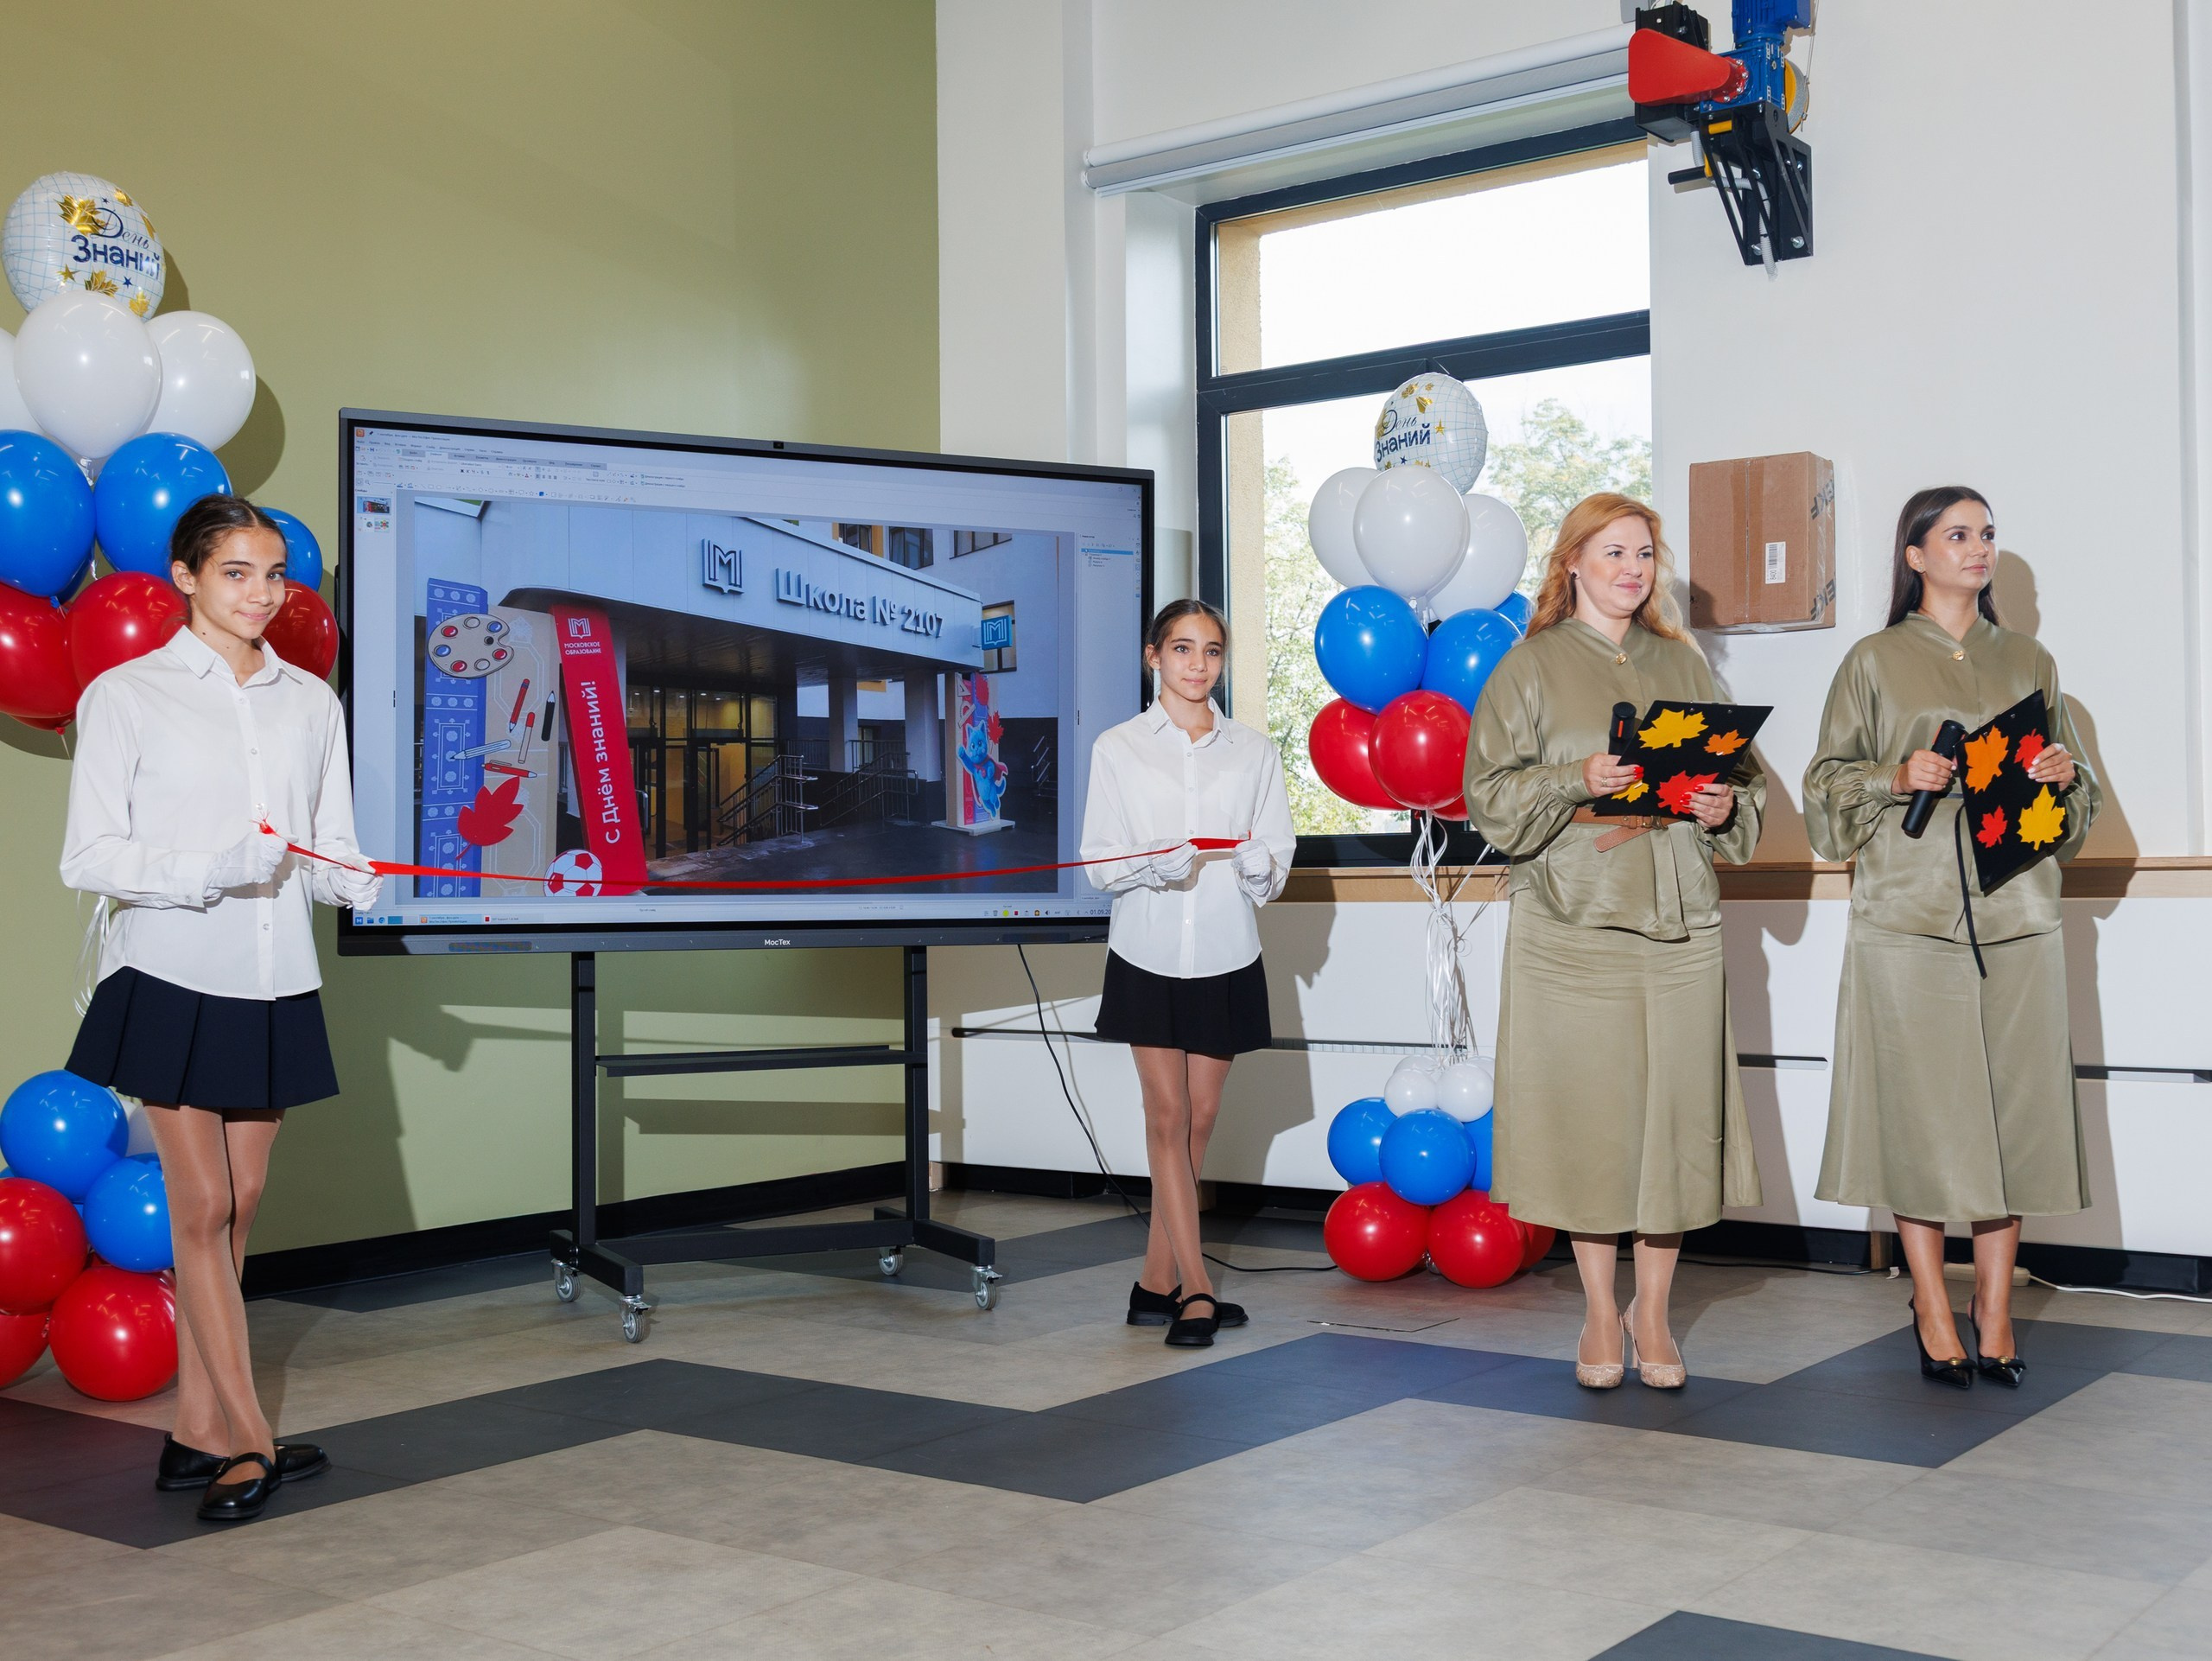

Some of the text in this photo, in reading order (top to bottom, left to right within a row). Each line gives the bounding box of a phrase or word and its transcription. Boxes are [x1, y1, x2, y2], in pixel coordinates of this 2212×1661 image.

[90, 207, 149, 249] День
[71, 234, 161, 280] Знаний
[1375, 423, 1431, 462] Знаний
[1381, 408, 1417, 436] День
[775, 567, 944, 639] Школа № 2107
[581, 680, 620, 843] С Днём знаний!
